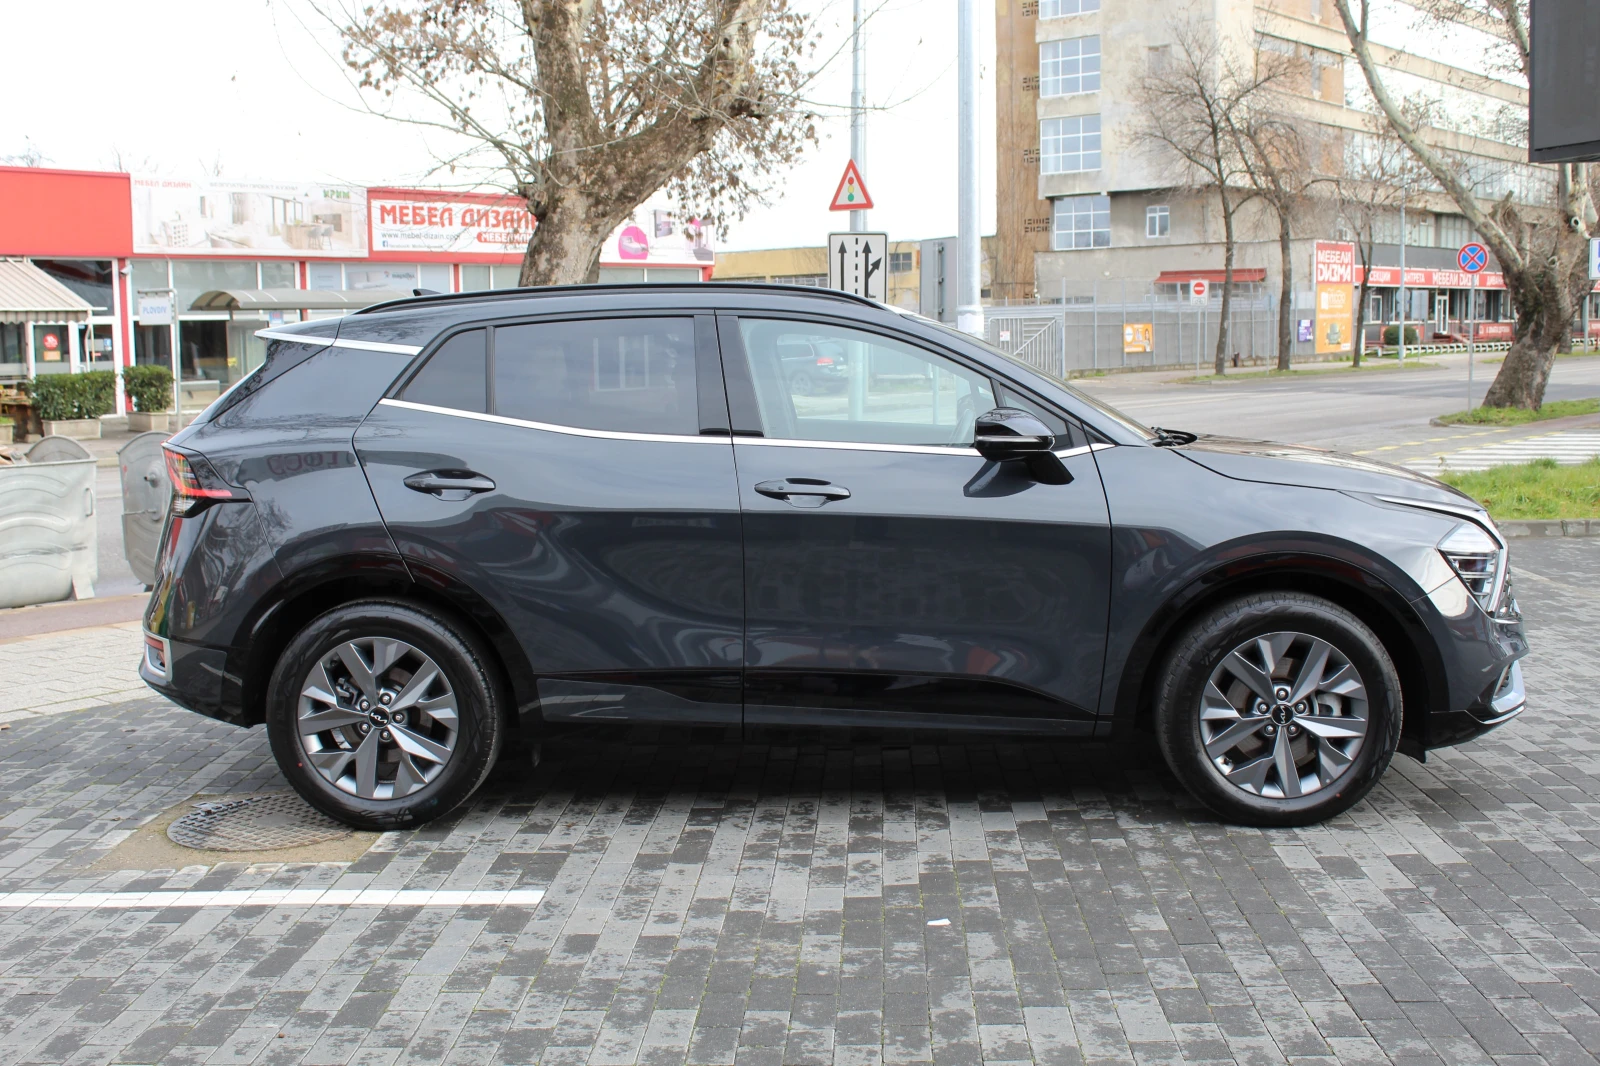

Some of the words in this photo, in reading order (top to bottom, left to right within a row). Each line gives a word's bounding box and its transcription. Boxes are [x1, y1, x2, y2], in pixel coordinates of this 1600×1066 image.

[380, 204, 453, 228] МЕБЕЛ
[1317, 249, 1351, 264] МЕБЕЛИ
[1432, 272, 1458, 285] МЕБЕЛИ
